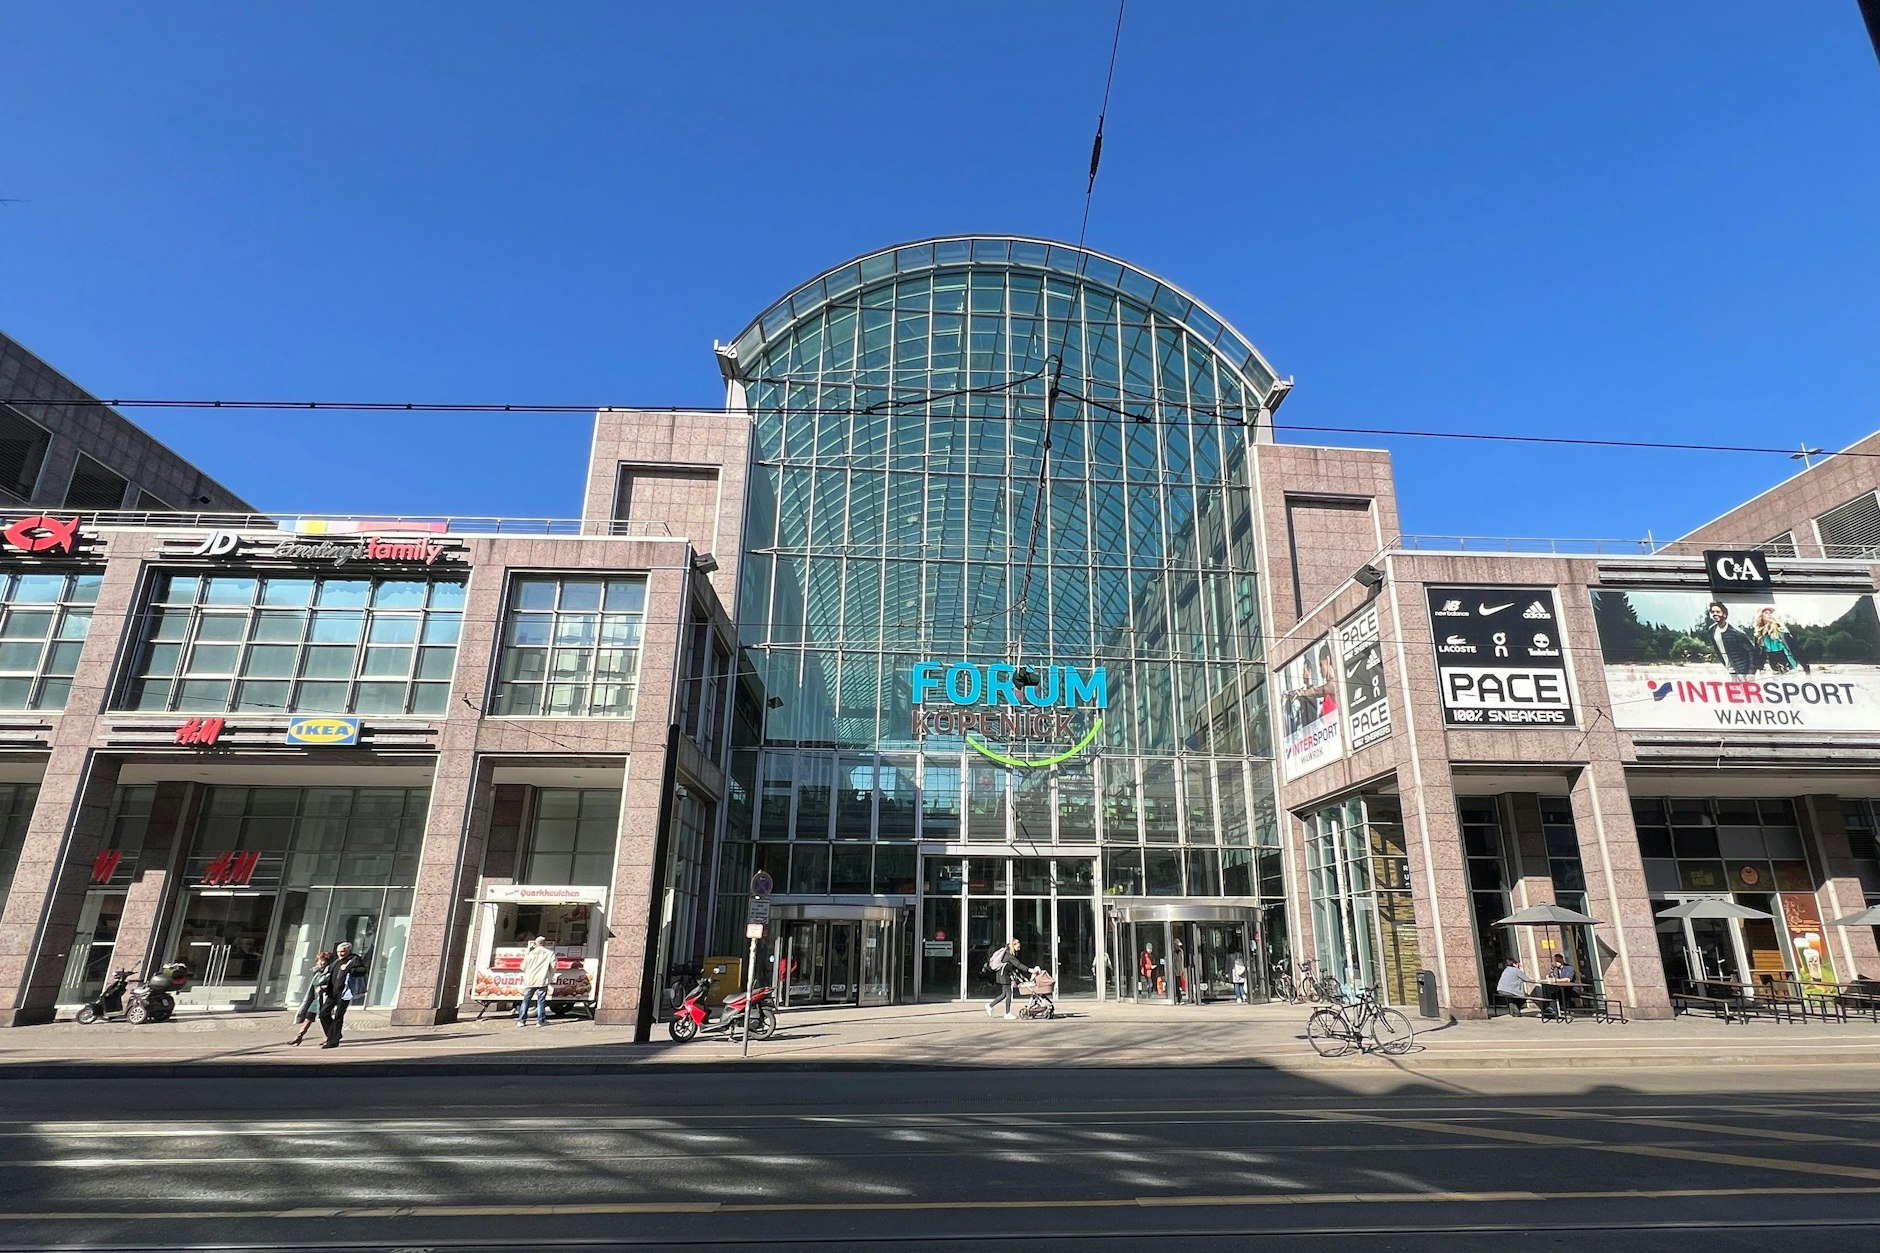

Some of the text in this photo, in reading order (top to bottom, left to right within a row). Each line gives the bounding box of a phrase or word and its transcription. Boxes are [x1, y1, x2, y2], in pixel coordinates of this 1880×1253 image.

[193, 530, 239, 555] JD
[367, 536, 445, 565] family
[1716, 557, 1763, 581] C&A
[1342, 611, 1377, 651] PACE
[1438, 645, 1478, 654] LACOSTE
[912, 661, 1108, 709] FORUM
[1449, 673, 1562, 703] PACE
[1677, 680, 1855, 705] INTERSPORT
[1352, 701, 1388, 736] PACE
[1453, 709, 1566, 723] 100% SNEAKERS
[1714, 709, 1804, 725] WAWROK
[173, 717, 226, 746] H&M
[296, 725, 349, 736] IKEA
[1292, 722, 1338, 757] INTERSPORT
